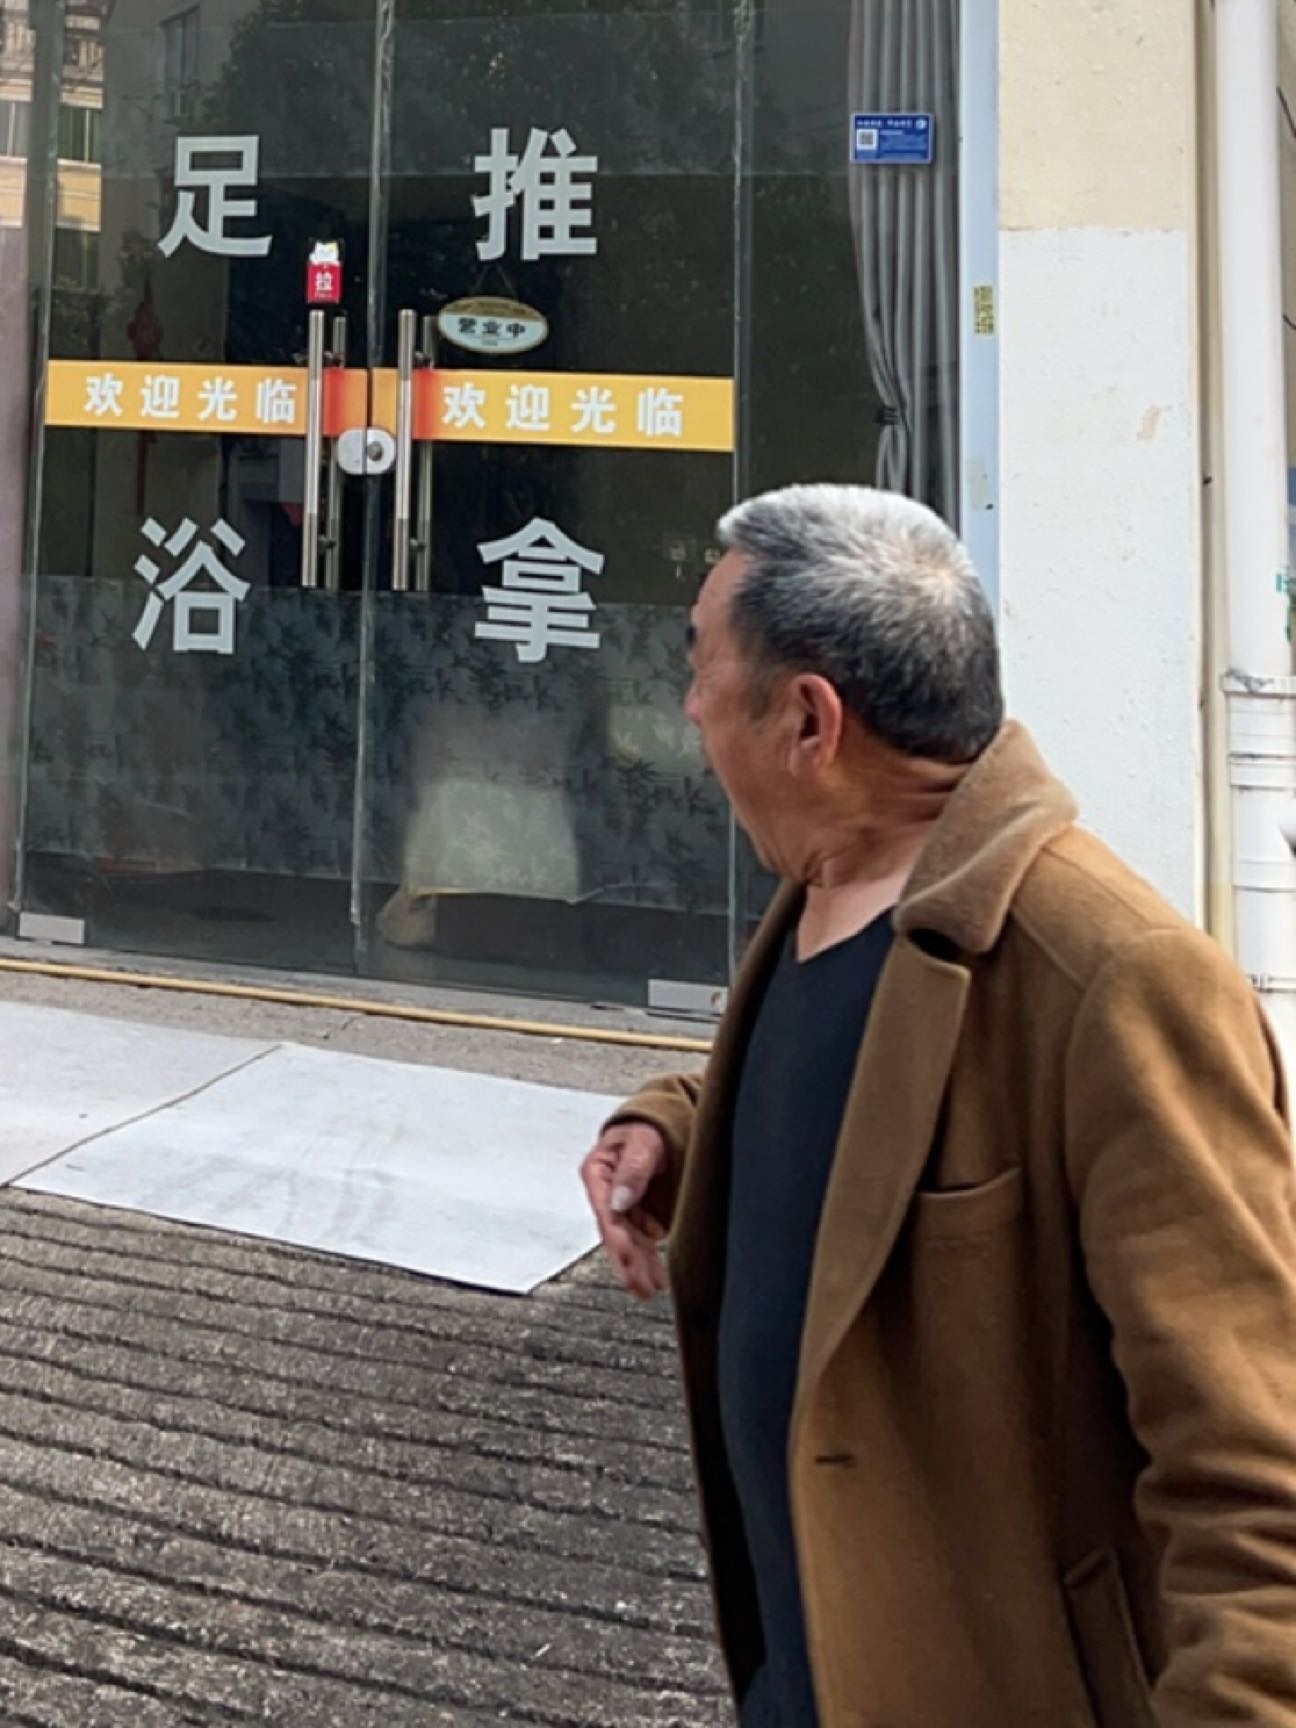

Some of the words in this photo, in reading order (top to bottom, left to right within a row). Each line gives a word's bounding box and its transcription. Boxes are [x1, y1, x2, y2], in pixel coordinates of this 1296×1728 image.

[156, 134, 273, 259] 足
[471, 126, 599, 261] 推
[459, 317, 526, 339] 营业中
[83, 372, 297, 424] 欢迎光临
[441, 380, 685, 438] 欢迎光临
[131, 516, 252, 656] 浴
[473, 516, 605, 664] 拿
